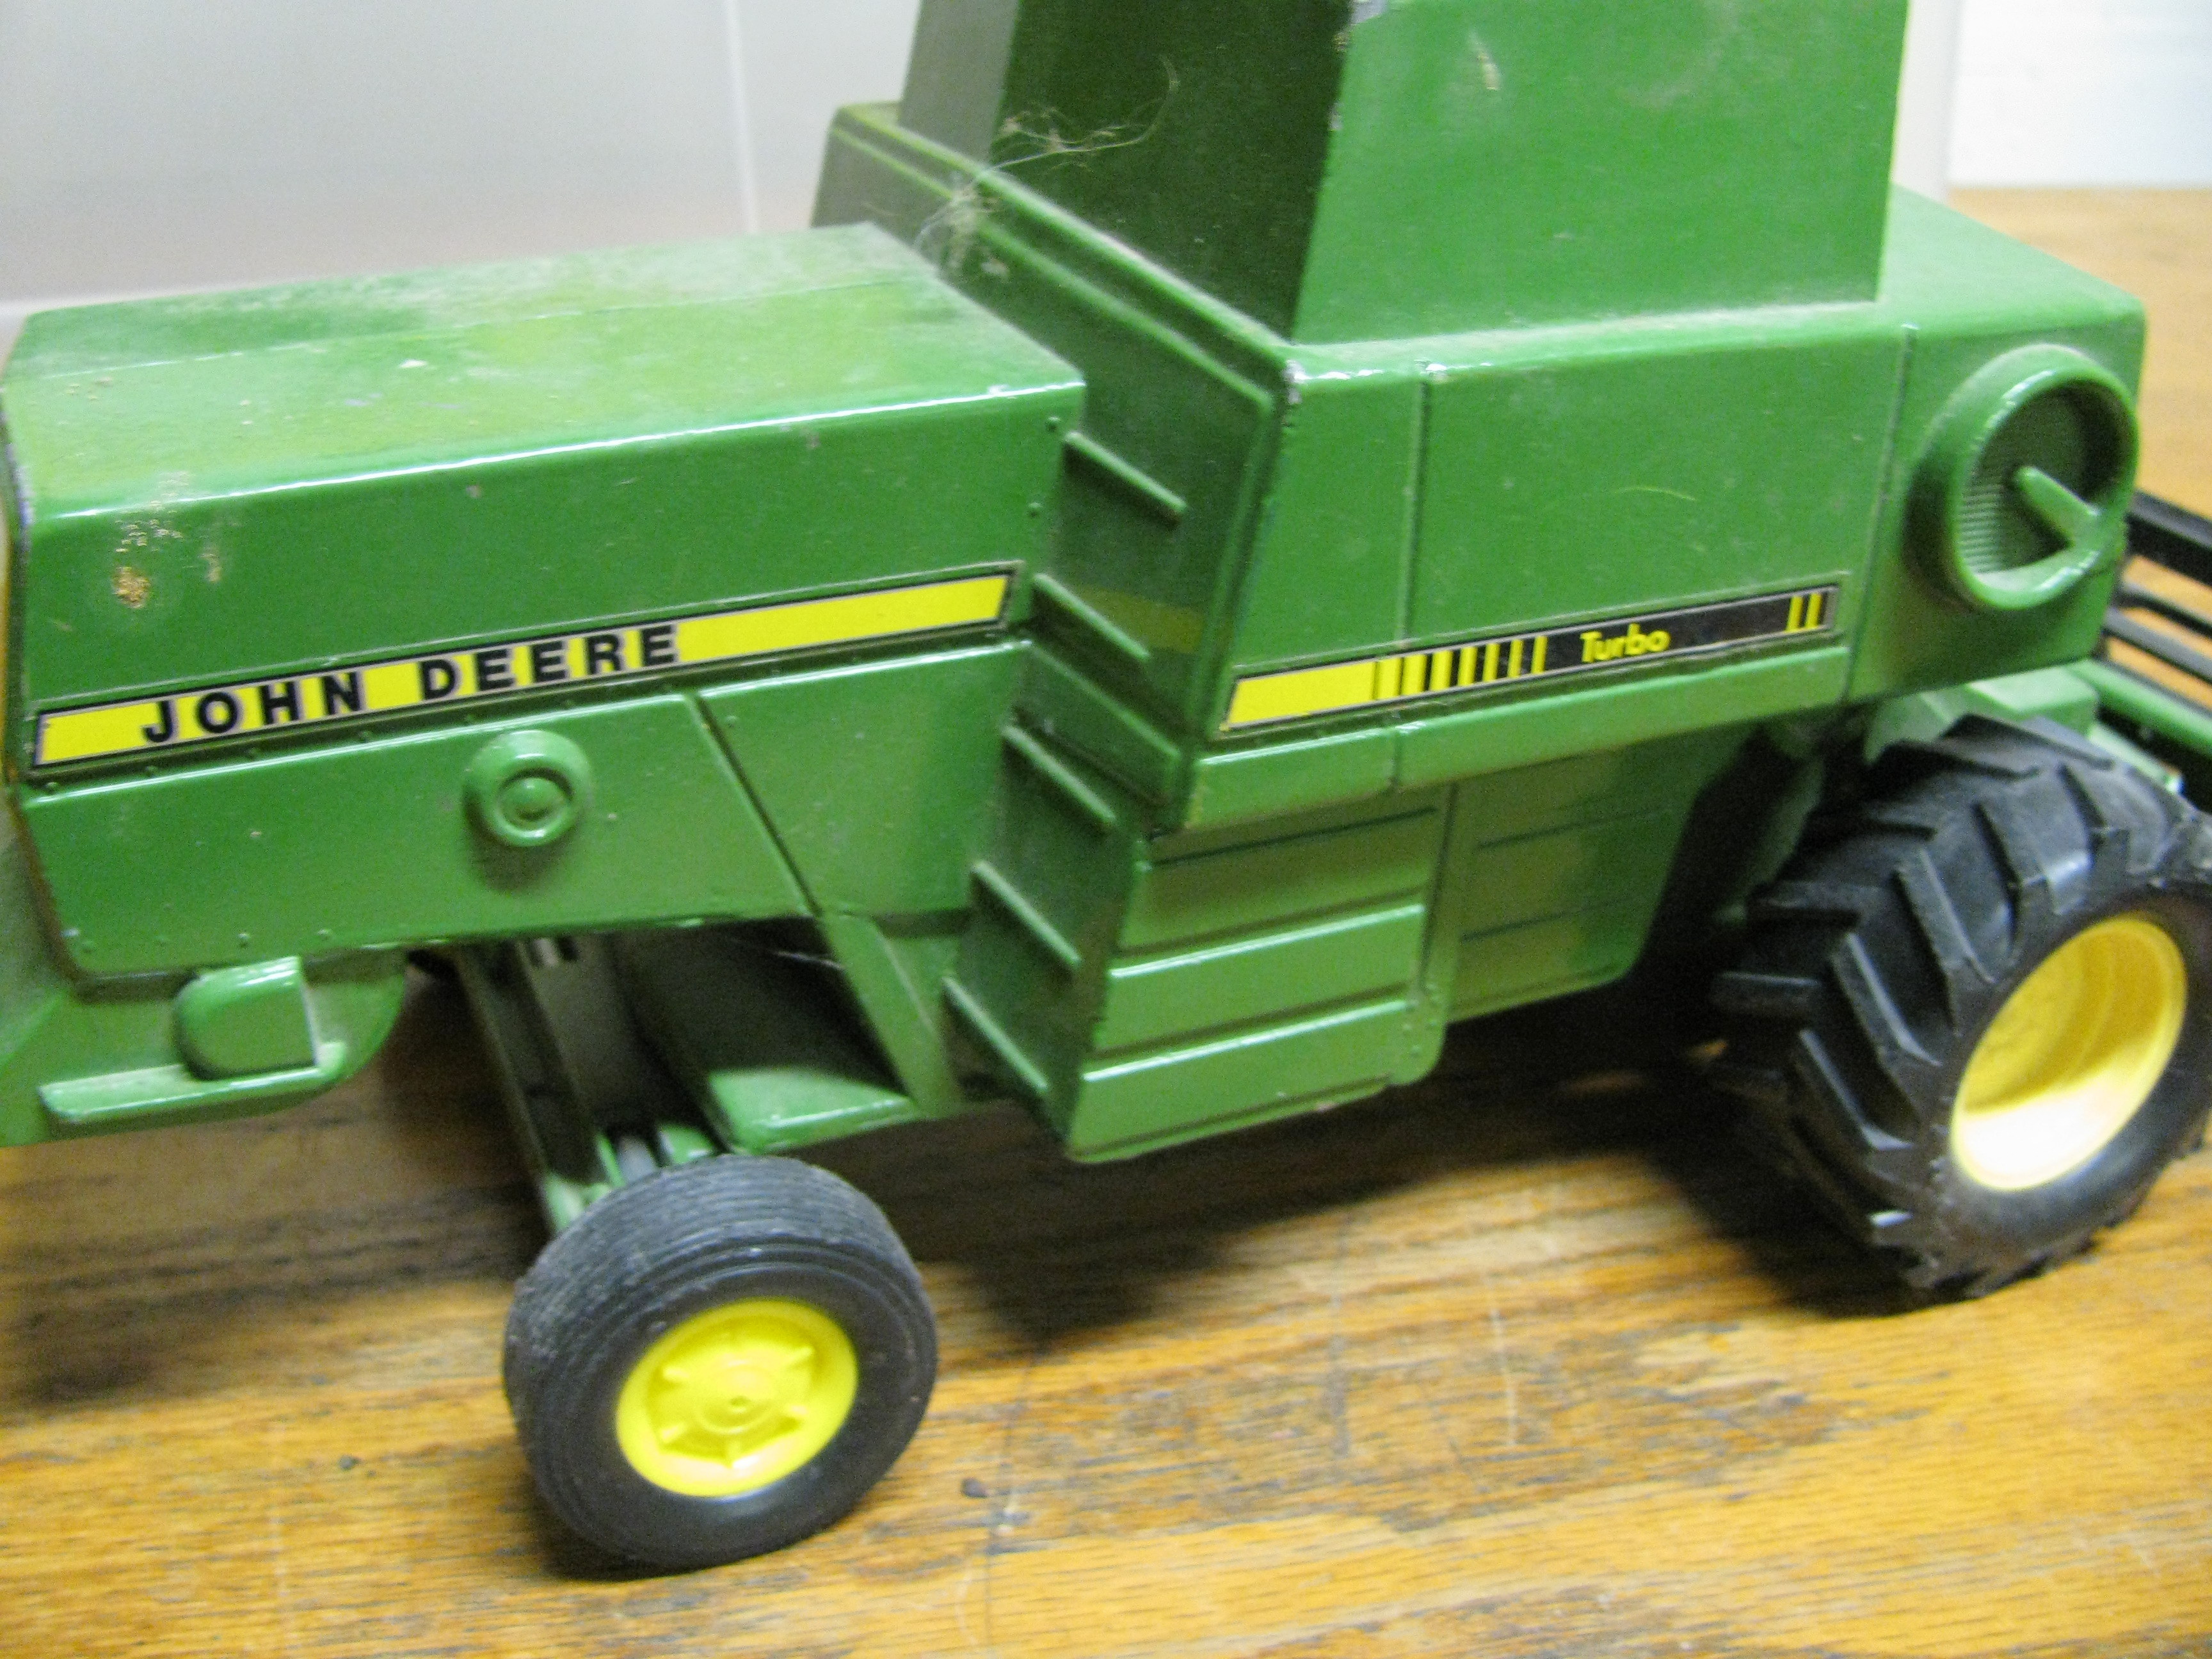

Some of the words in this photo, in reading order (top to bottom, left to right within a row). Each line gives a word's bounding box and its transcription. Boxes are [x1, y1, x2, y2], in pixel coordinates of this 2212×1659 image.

[1580, 623, 1671, 662] Turbo
[143, 671, 360, 742] JOHN
[421, 625, 677, 700] DEERE
